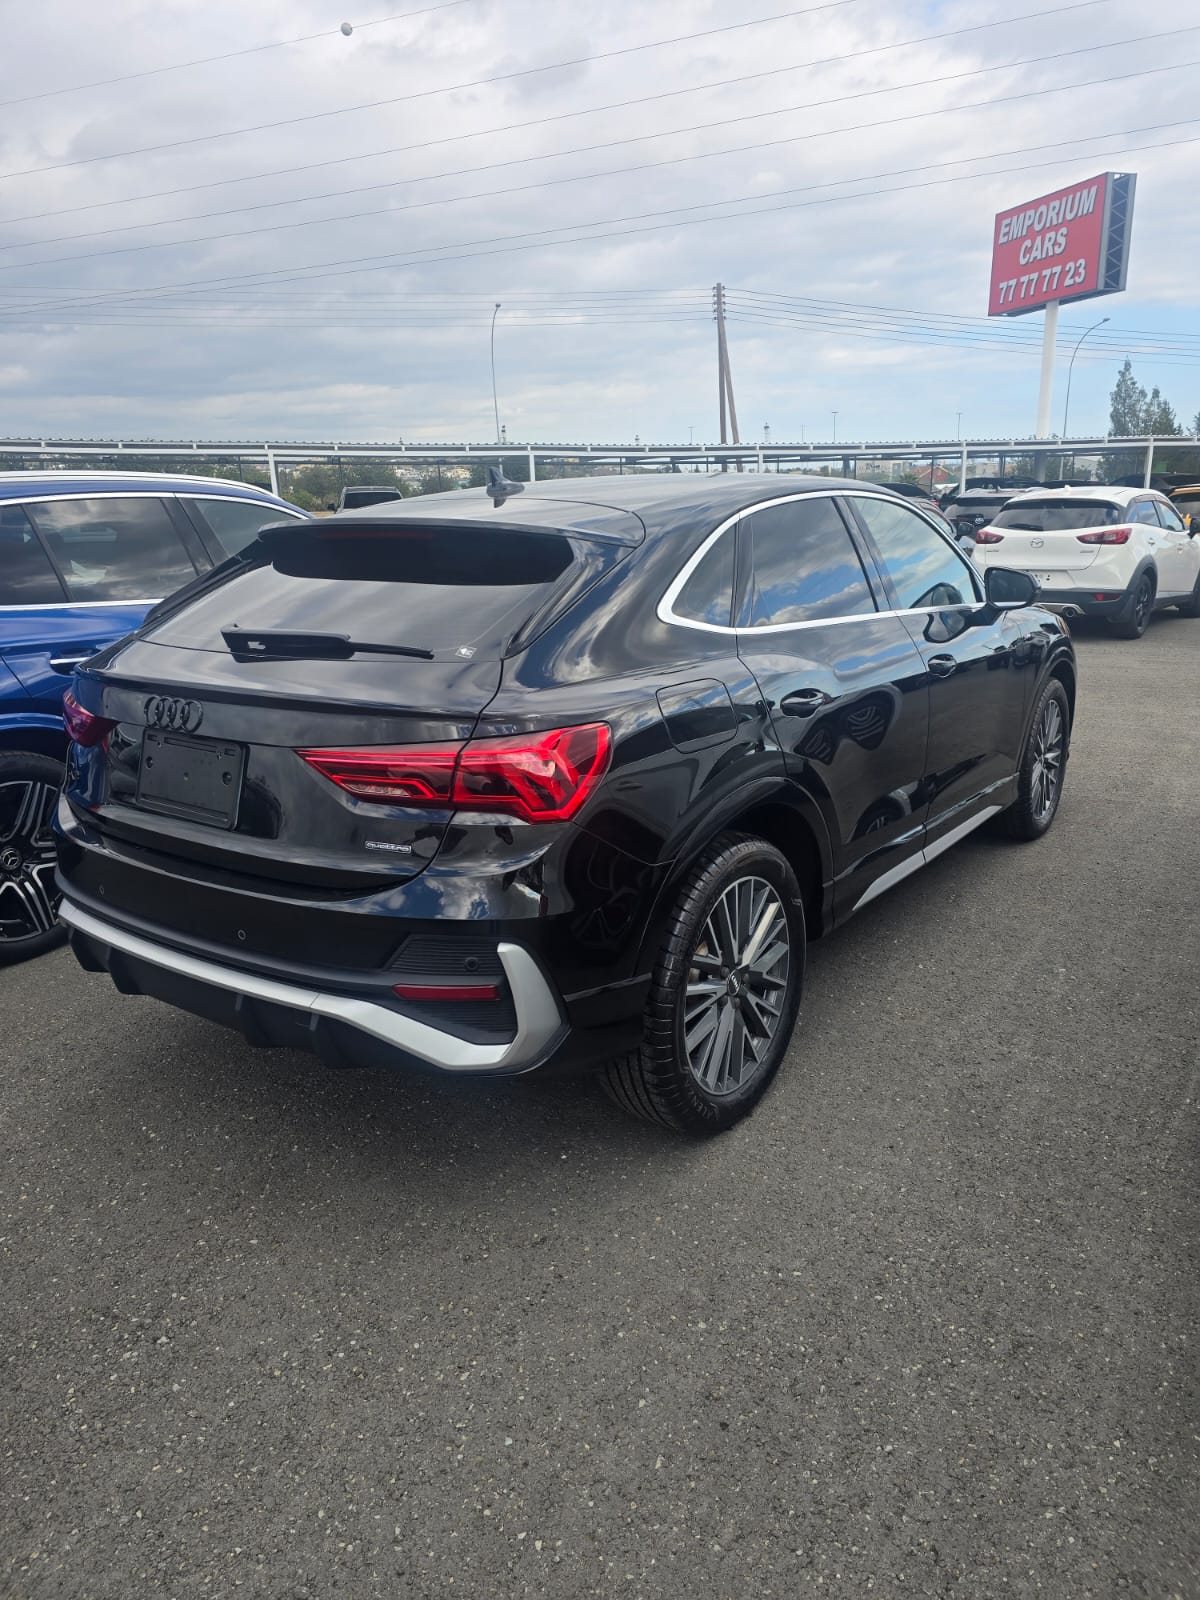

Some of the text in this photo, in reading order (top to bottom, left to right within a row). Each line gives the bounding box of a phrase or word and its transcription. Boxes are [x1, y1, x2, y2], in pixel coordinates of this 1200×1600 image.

[998, 185, 1098, 244] EMPORIUM
[1019, 227, 1068, 266] CARS
[999, 258, 1086, 304] 77 77 77 23
[366, 841, 410, 853] quattro
